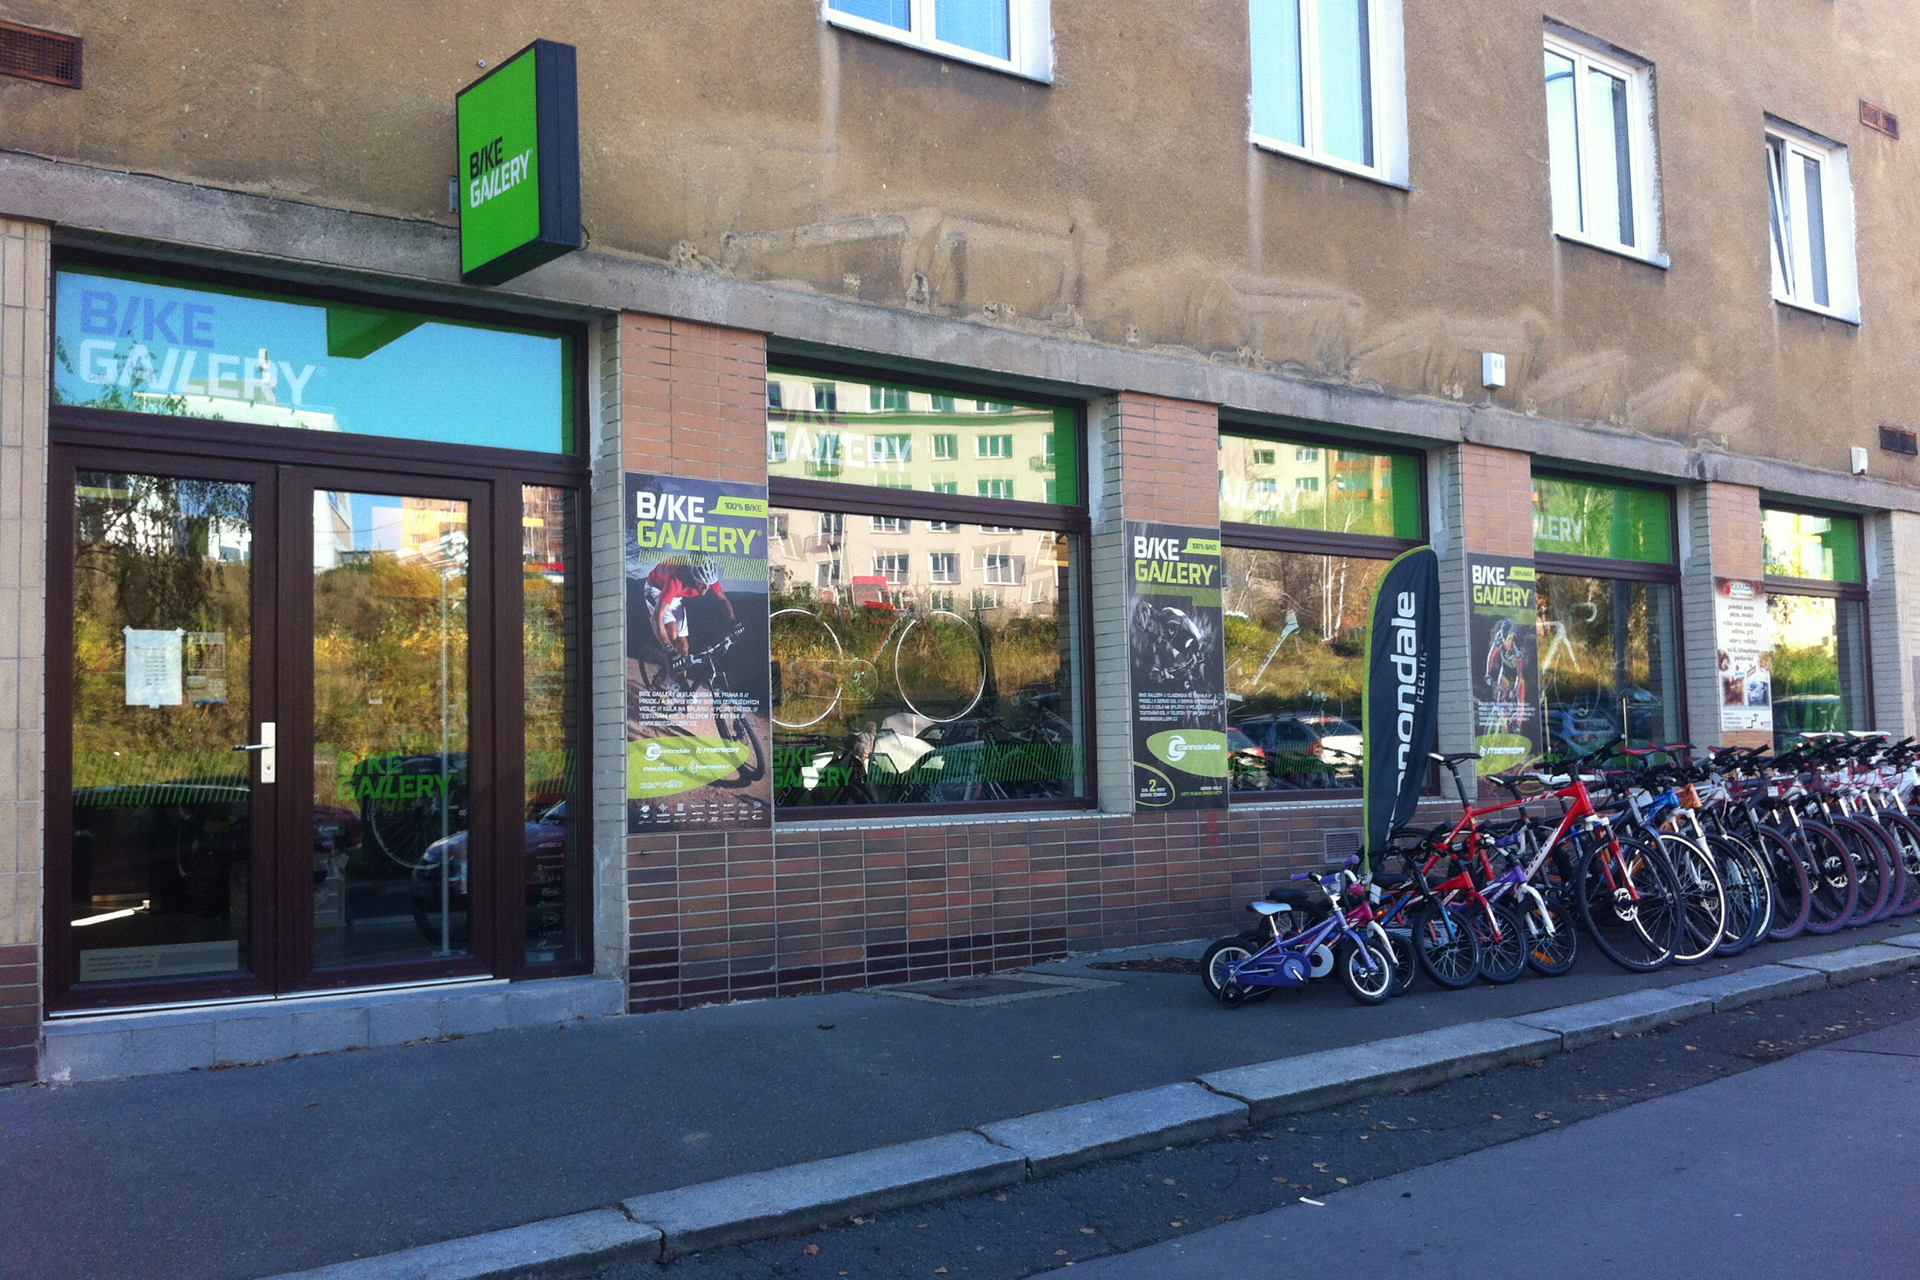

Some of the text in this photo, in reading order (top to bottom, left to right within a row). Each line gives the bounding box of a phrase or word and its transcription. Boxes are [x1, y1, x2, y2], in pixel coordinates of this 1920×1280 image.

[470, 136, 503, 180] BIKE
[470, 149, 529, 209] GALLERY
[80, 290, 214, 349] BIKE
[79, 338, 316, 407] GALLERY
[636, 491, 705, 523] BIKE
[724, 501, 762, 513] 100% BIKE
[637, 520, 757, 555] GALLERY
[1134, 535, 1180, 561] BIKE
[1134, 559, 1214, 586] GALLERY
[1472, 564, 1505, 586] BIKE
[1473, 584, 1530, 607] GALLERY
[338, 750, 403, 775] BIKE
[338, 774, 453, 800] GALLERY
